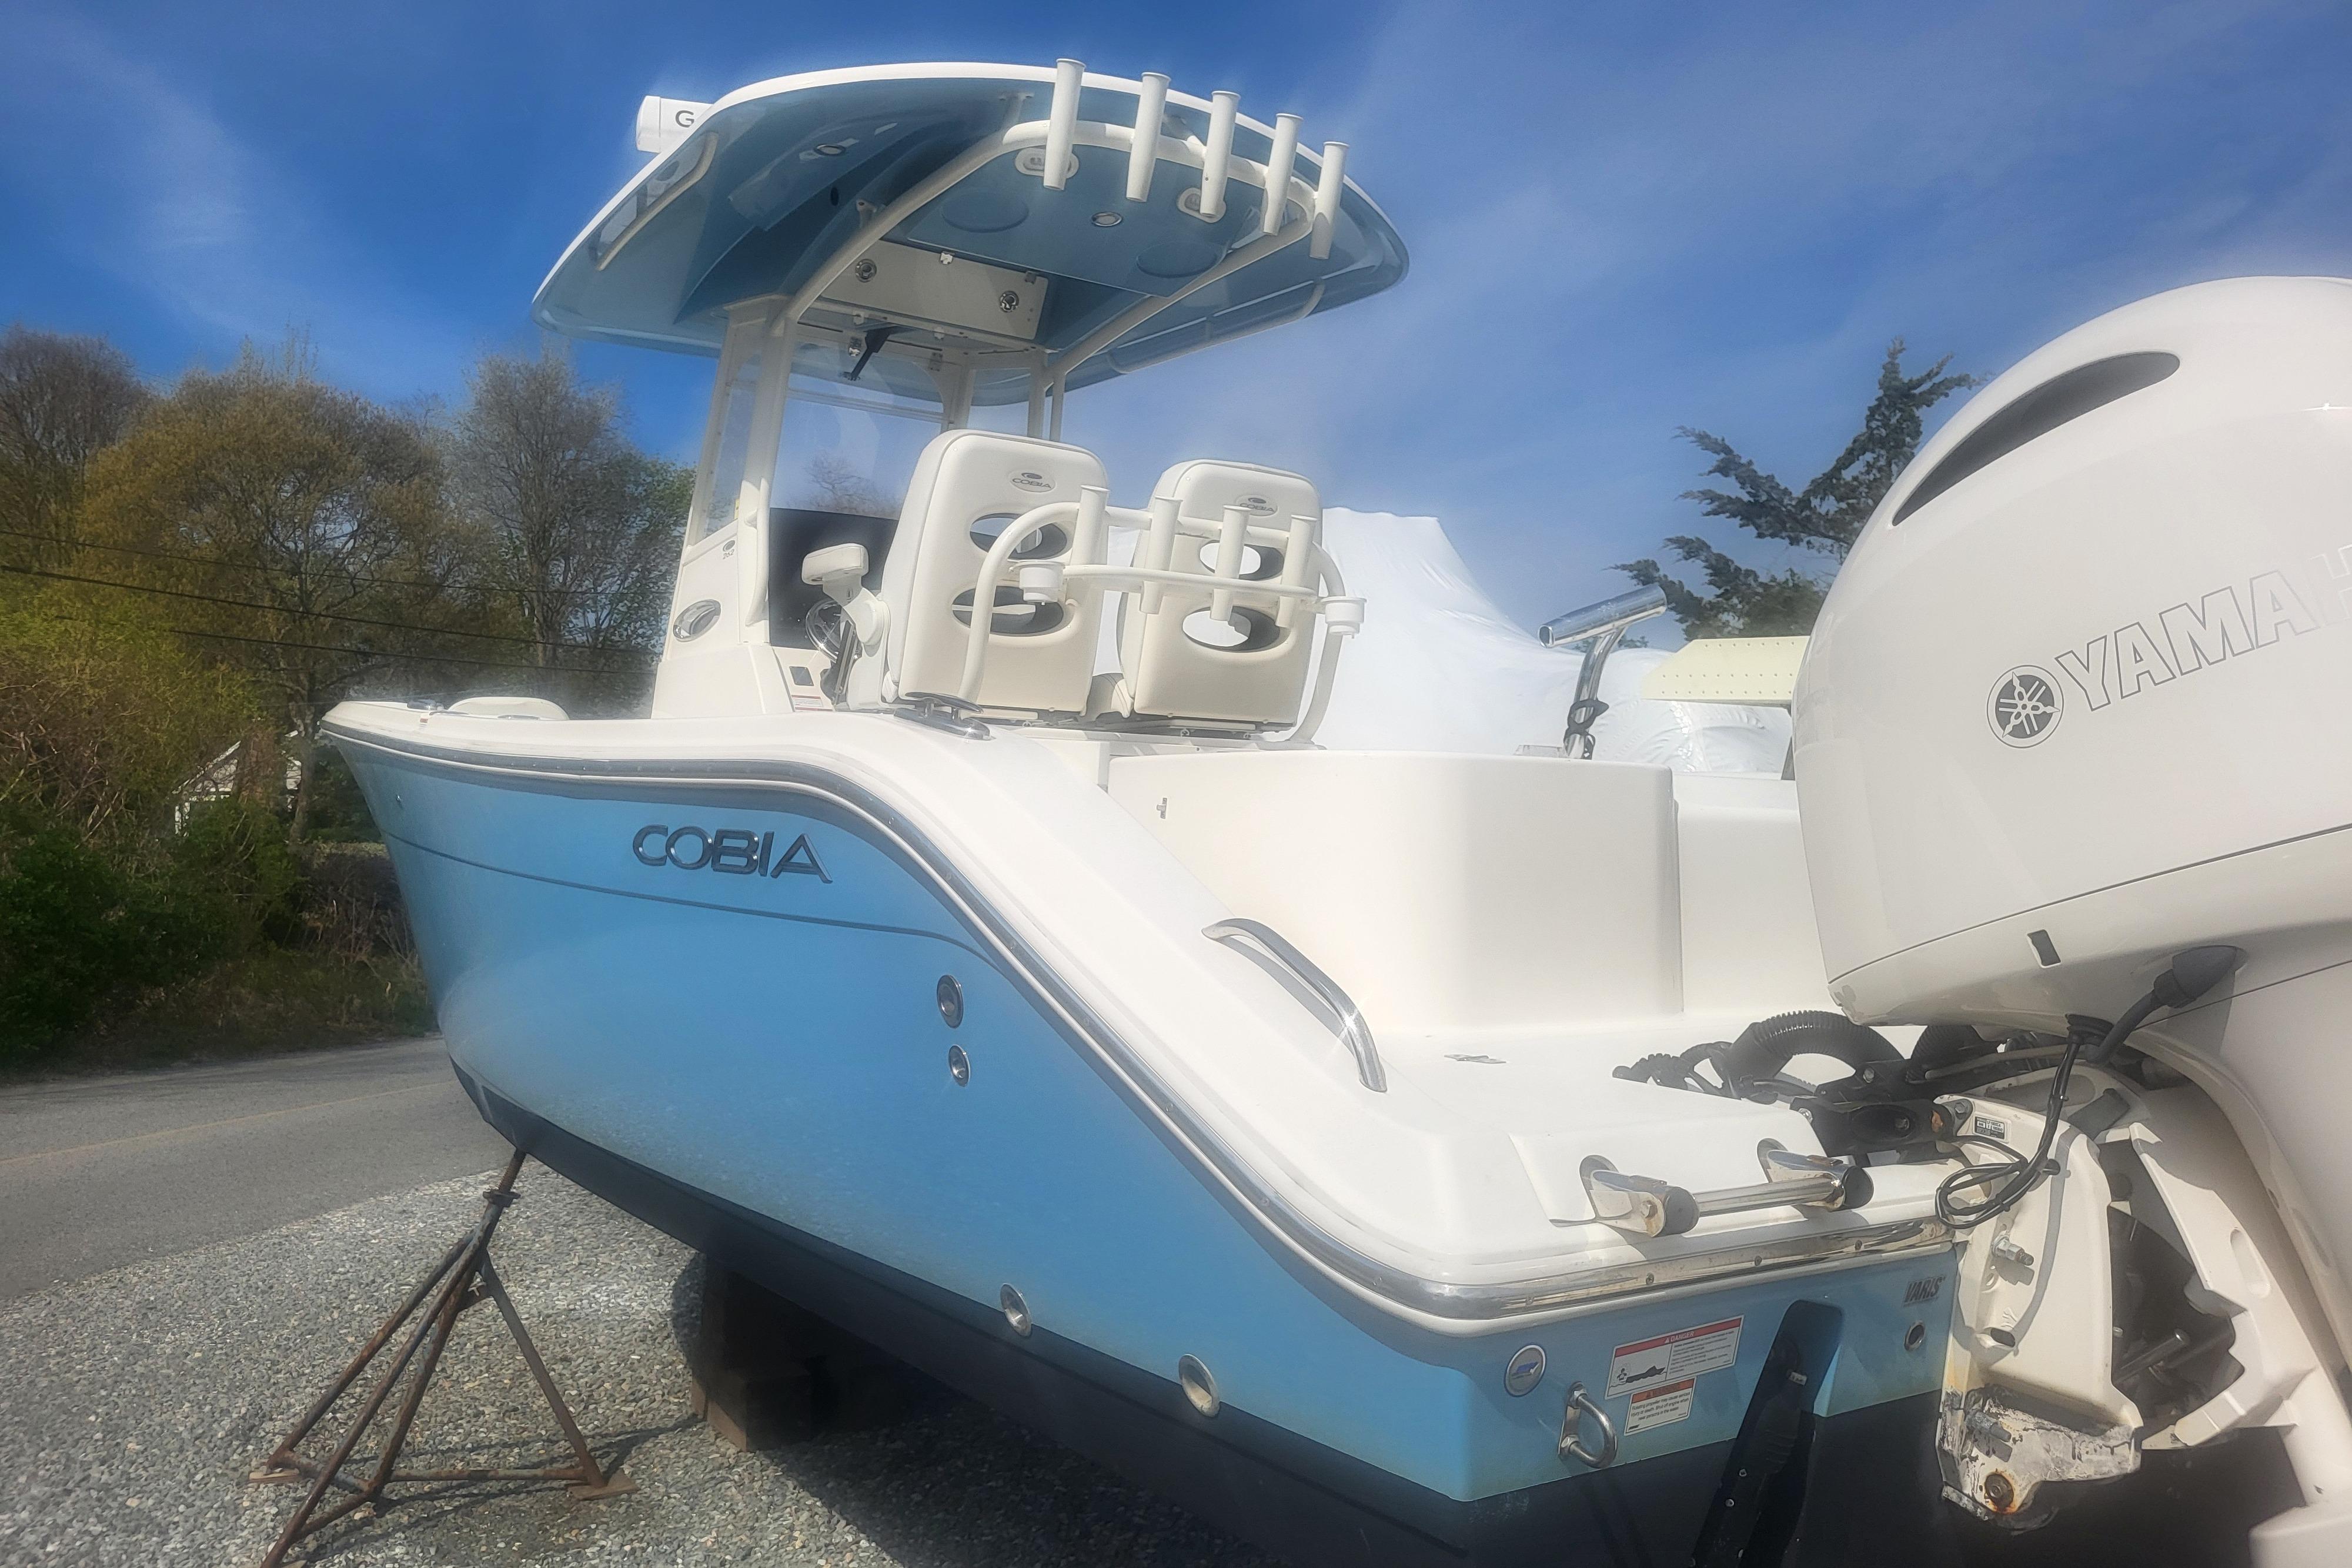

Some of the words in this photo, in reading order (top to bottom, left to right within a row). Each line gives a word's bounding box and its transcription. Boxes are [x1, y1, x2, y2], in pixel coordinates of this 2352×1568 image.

[1013, 479, 1051, 489] COBIA
[633, 824, 833, 884] COBIA
[1671, 1331, 1694, 1342] DANGER
